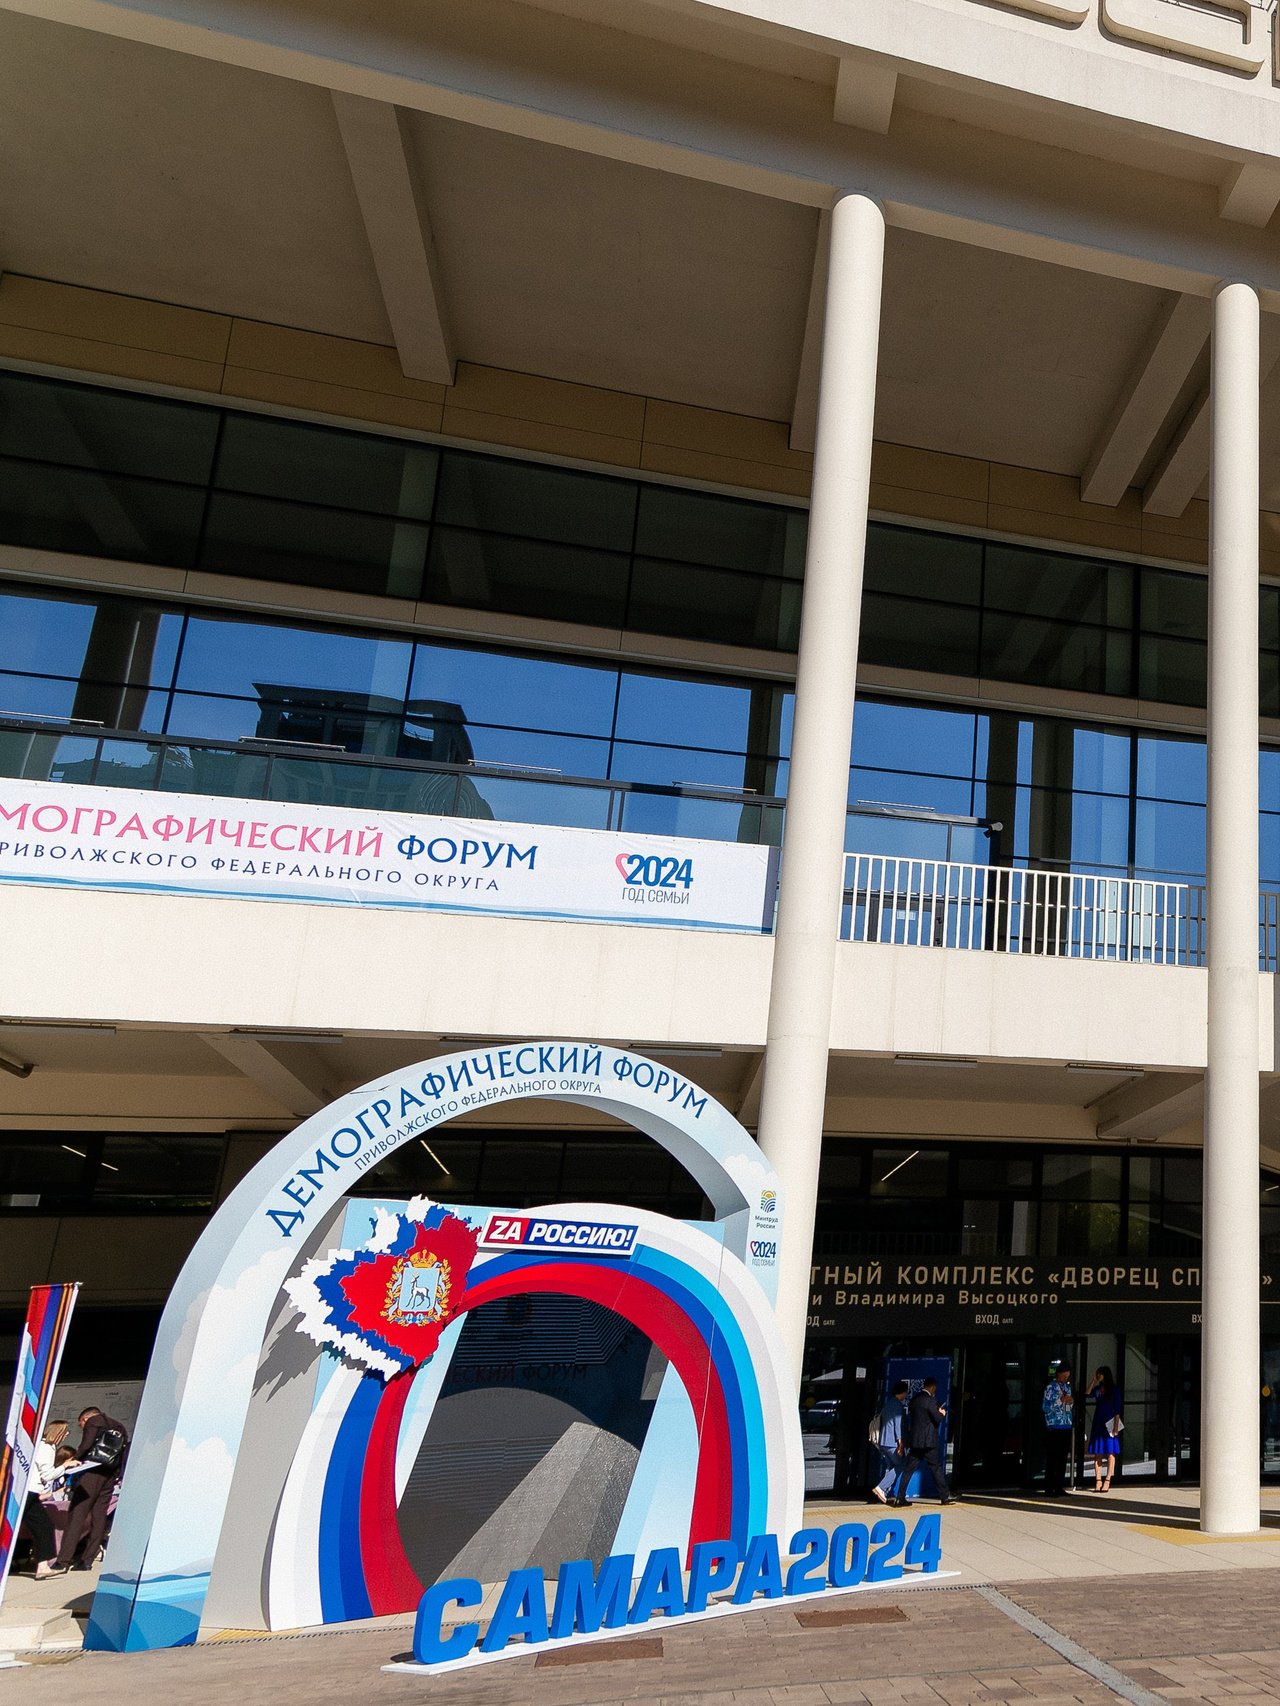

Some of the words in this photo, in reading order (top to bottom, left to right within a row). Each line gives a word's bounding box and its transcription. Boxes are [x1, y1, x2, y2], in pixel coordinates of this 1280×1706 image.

[397, 834, 539, 870] ФОРУМ
[211, 857, 402, 884] ФЕДЕРАЛЬНОГО
[414, 872, 500, 891] ОКРУГА
[624, 854, 694, 889] 2024
[265, 1044, 603, 1237] ДЕМОГРАФИЧЕСКИЙ
[612, 1056, 709, 1119] ФОРУМ
[354, 1100, 458, 1171] ПРИВОЛЖСКОГО
[461, 1079, 557, 1107] ФЕДЕРАЛЬНОГО
[559, 1079, 602, 1094] ОКРУГА
[488, 1220, 522, 1241] ZA
[528, 1223, 634, 1248] РОССИЮ!
[753, 1241, 776, 1258] 2024
[810, 1261, 882, 1285] ТНЫЙ
[897, 1265, 1034, 1285] КОМПЛЕКС
[1048, 1266, 1159, 1288] «ДВОРЕЦ
[835, 1290, 945, 1308] Владимира
[958, 1290, 1058, 1306] Высоцкого
[975, 1314, 1000, 1325] ВХОД
